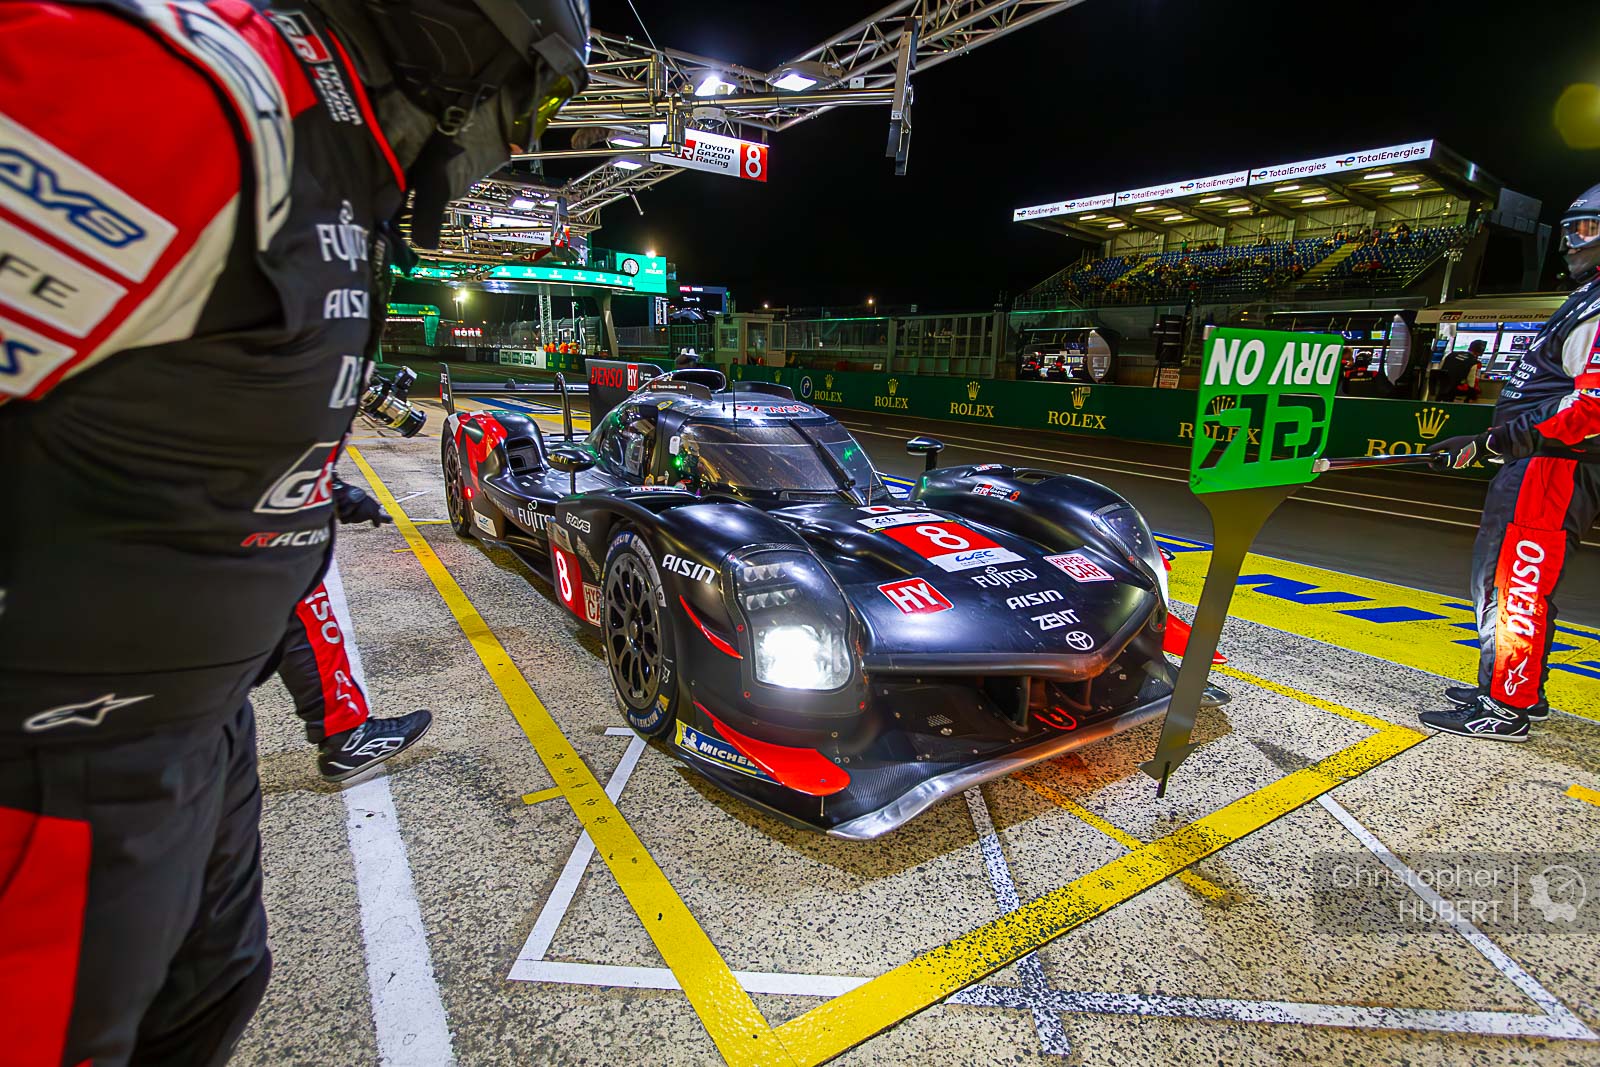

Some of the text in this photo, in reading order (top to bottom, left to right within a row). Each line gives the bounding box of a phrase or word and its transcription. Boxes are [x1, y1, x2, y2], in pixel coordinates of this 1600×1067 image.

[696, 149, 731, 161] GAZOO
[699, 141, 735, 154] TOYOTA
[1357, 145, 1426, 163] TotalEnergies
[695, 155, 729, 169] Racing
[745, 145, 762, 178] 8
[1268, 161, 1327, 178] TotalEnergies
[1195, 175, 1245, 190] TotalEnergies
[1076, 196, 1114, 208] TotalEnergies
[1131, 187, 1174, 200] TotalEnergies
[1027, 205, 1060, 216] TotalEnergies
[1499, 313, 1534, 321] GAZOO
[1203, 338, 1266, 386] ON
[1268, 342, 1342, 385] DRV
[590, 366, 623, 389] DENSO
[627, 368, 638, 387] HY
[814, 390, 843, 402] ROLEX
[874, 395, 909, 409] ROLEX
[950, 402, 995, 418] ROLEX
[1047, 410, 1107, 430] ROLEX
[971, 486, 989, 497] GR
[1009, 490, 1021, 502] 8
[566, 512, 591, 534] RAYS
[915, 525, 971, 550] 8
[955, 550, 995, 562] WEC
[1051, 556, 1088, 567] HYPER
[556, 550, 572, 601] 8
[662, 553, 716, 584] AISIN
[1063, 564, 1107, 579] CAR
[971, 567, 1038, 589] FUJITSU
[1506, 539, 1546, 637] DENSO
[886, 583, 939, 613] HY
[1006, 589, 1065, 610] AISIN
[1031, 609, 1081, 631] ZENT
